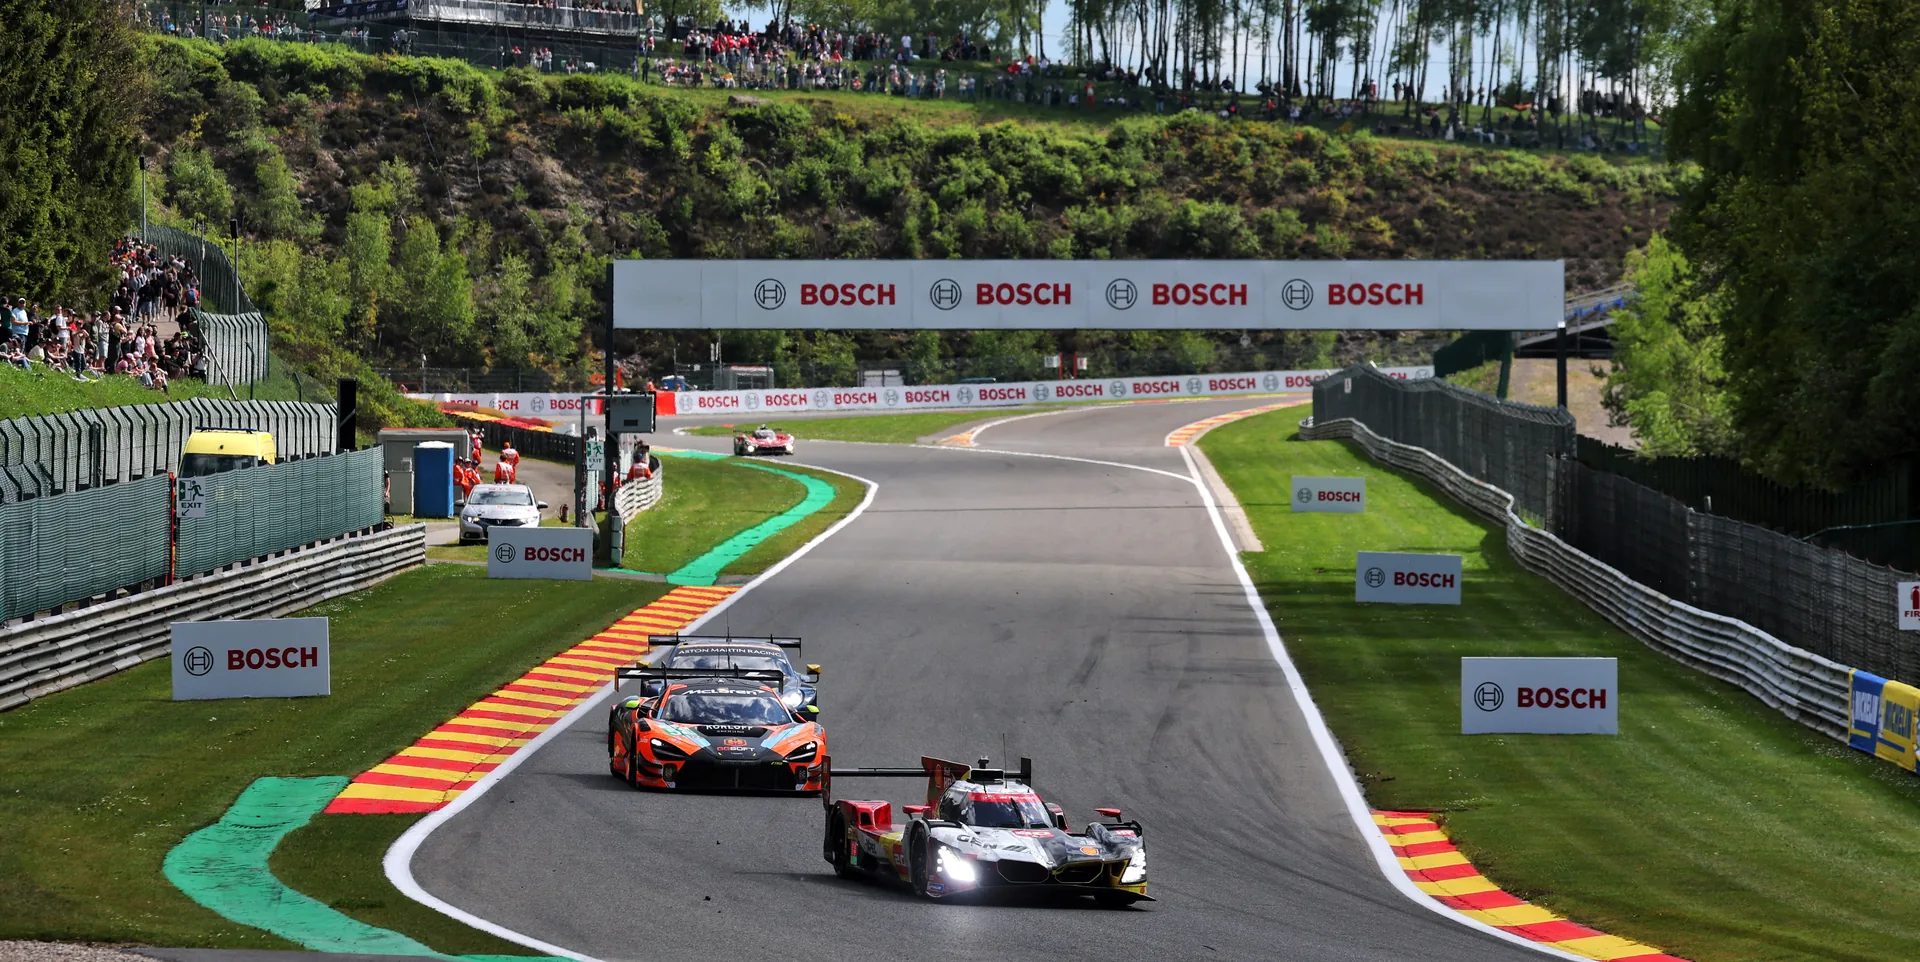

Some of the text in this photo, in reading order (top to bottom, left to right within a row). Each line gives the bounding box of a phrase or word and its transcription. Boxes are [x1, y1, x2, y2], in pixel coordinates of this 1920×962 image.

[801, 283, 1424, 306] BOSCH BOSCH BOSCH BOSCH
[550, 399, 592, 411] BOSCH
[698, 395, 739, 408] BOSCH
[765, 393, 807, 407] BOSCH
[834, 391, 878, 405] BOSCH
[905, 389, 950, 403] BOSCH
[979, 387, 1025, 401] BOSCH
[1056, 385, 1103, 397] BOSCH
[1133, 381, 1180, 395] BOSCH
[1209, 378, 1256, 391] BOSCH
[1318, 491, 1360, 502] BOSCH
[525, 547, 585, 562] BOSCH
[1394, 571, 1455, 588] BOSCH
[227, 646, 318, 670] BOSCH
[1517, 687, 1607, 709] BOSCH
